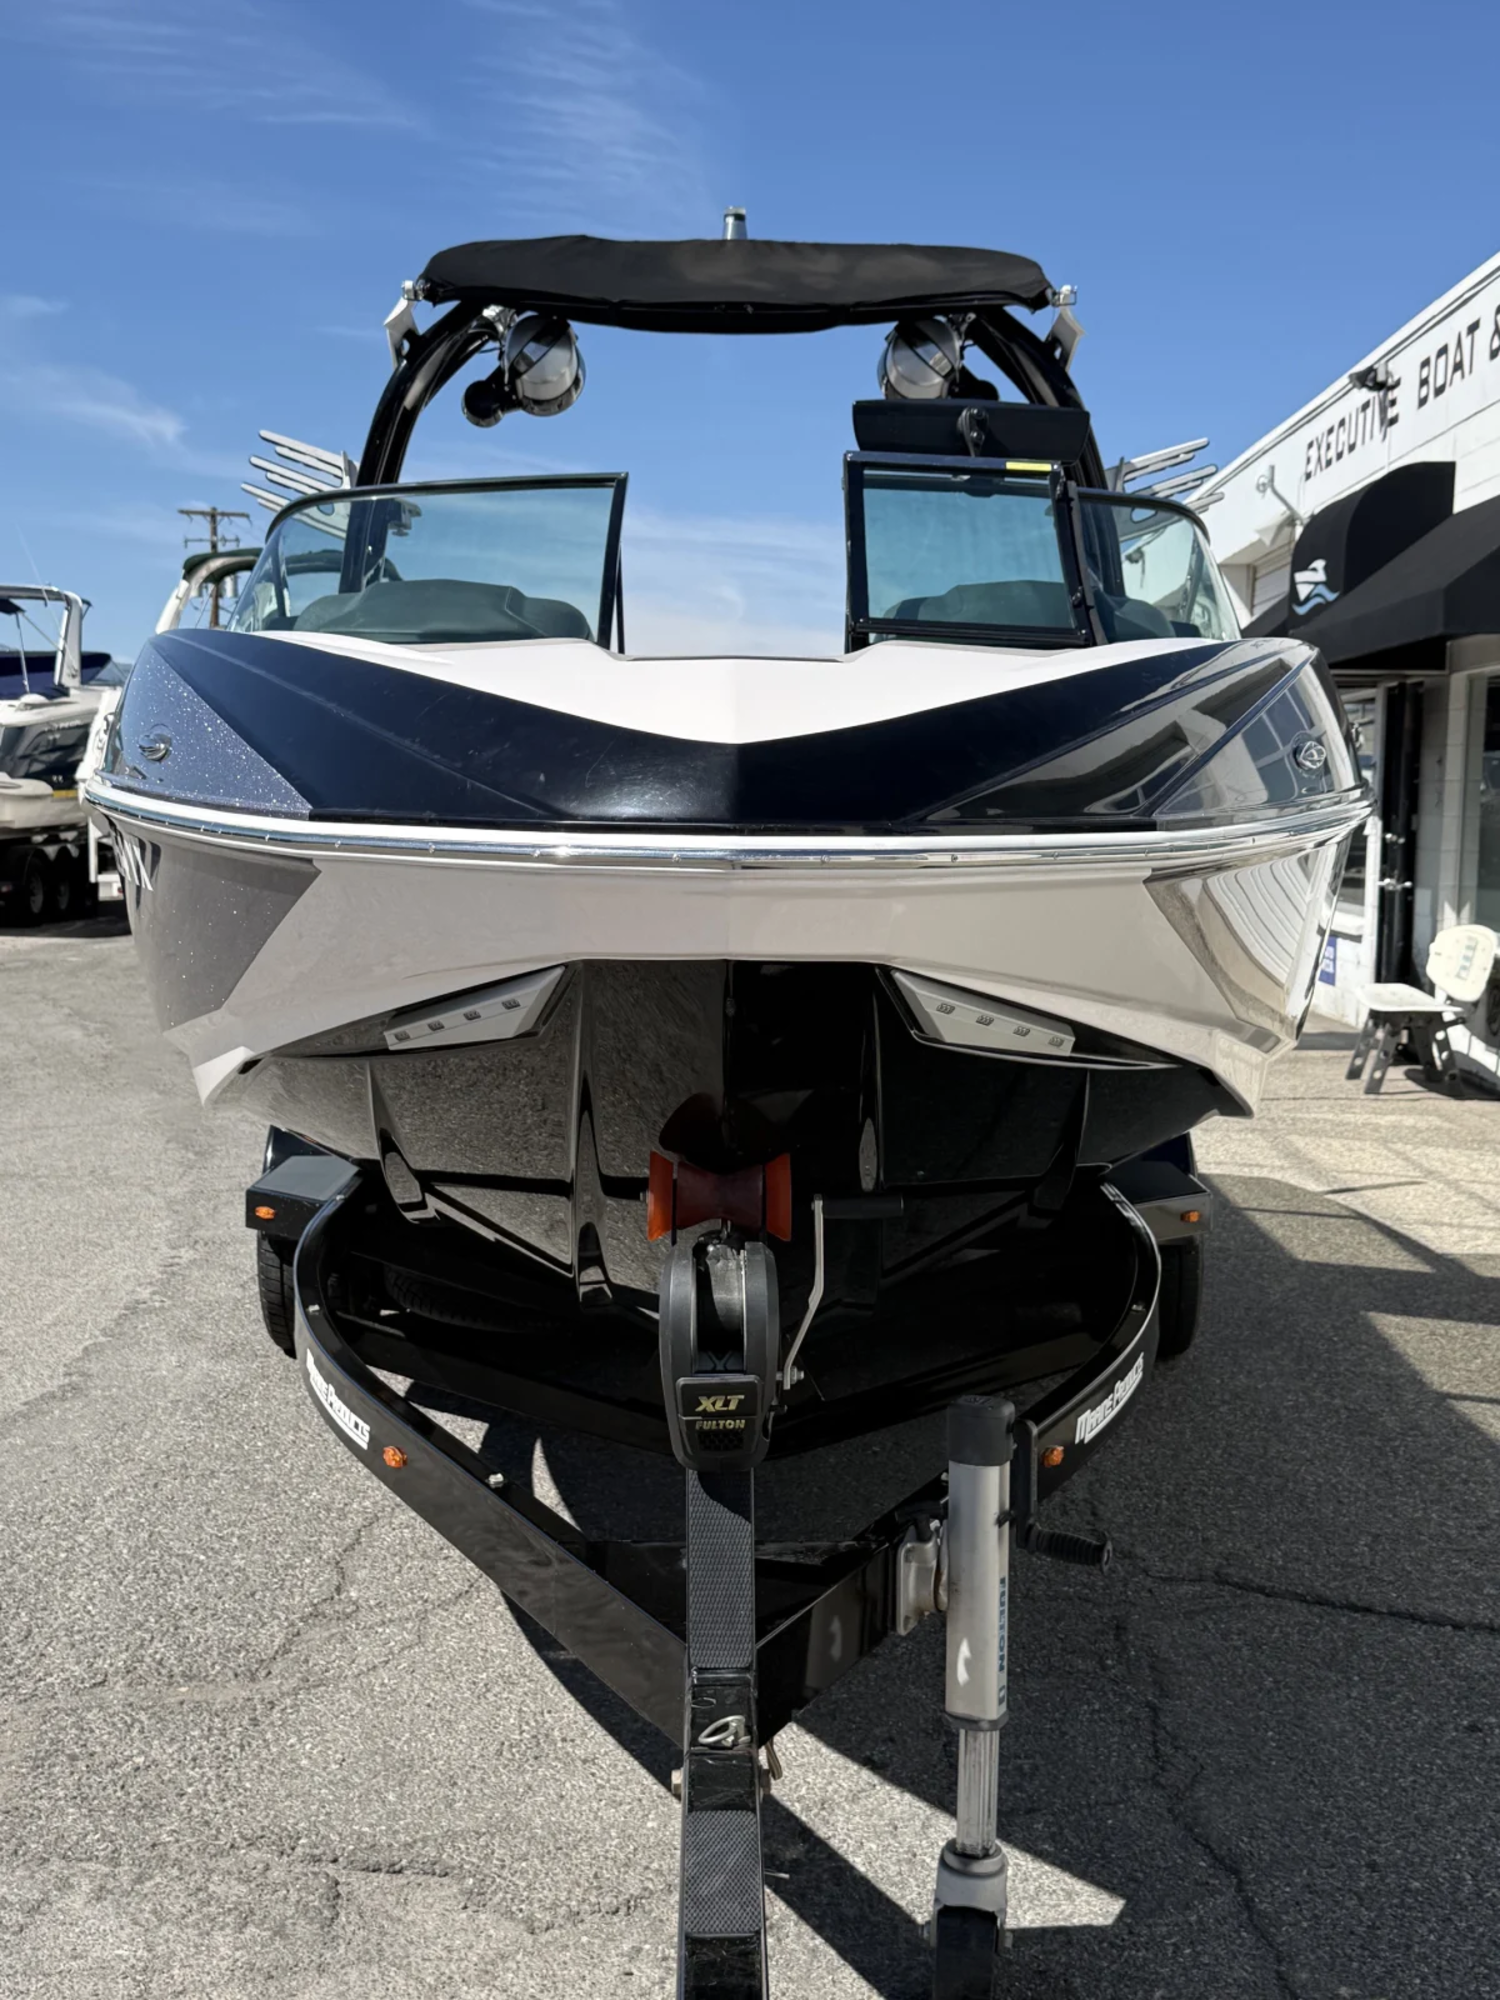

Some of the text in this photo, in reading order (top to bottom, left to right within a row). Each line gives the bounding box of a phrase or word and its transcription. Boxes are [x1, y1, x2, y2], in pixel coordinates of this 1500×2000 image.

[1304, 376, 1402, 482] EXECUTIVE
[1417, 317, 1481, 410] BOAT
[695, 1395, 745, 1412] XLT
[695, 1419, 745, 1430] FULTON
[998, 1576, 1006, 1673] FULTON
